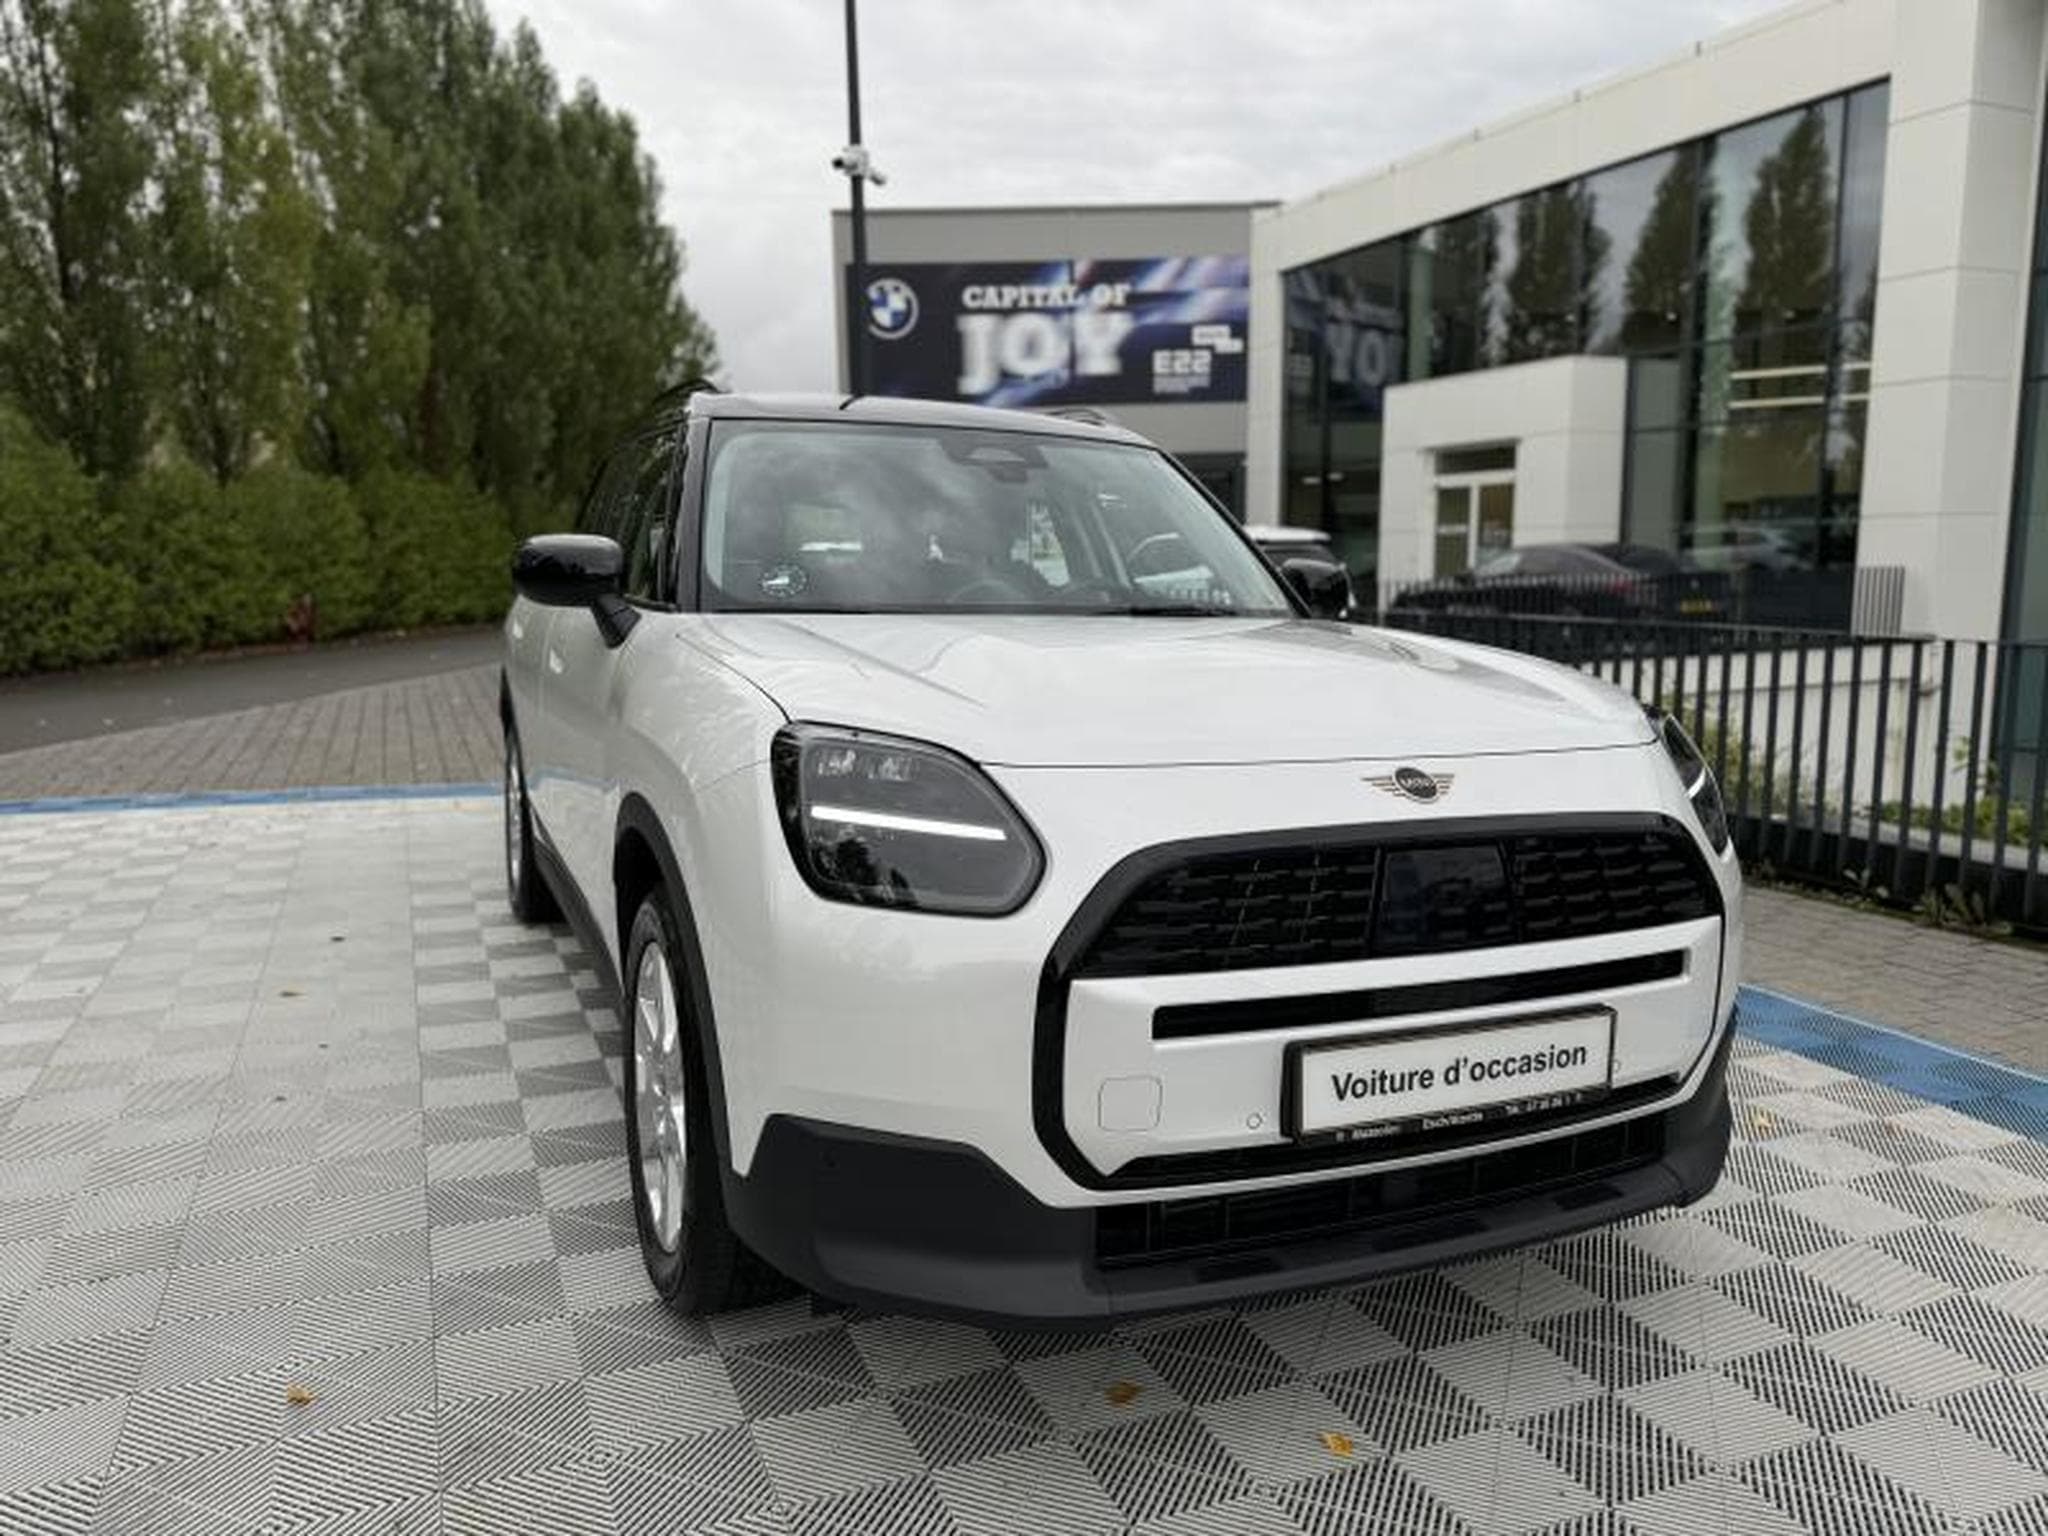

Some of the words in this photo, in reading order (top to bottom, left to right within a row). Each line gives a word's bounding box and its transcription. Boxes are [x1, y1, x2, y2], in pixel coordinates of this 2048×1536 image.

[962, 285, 1078, 308] CAPITAL
[1091, 283, 1132, 306] OF
[957, 312, 1135, 395] JOY
[1153, 349, 1212, 374] E22
[1331, 1066, 1435, 1101] Voiture
[1444, 1044, 1587, 1086] d'occasion
